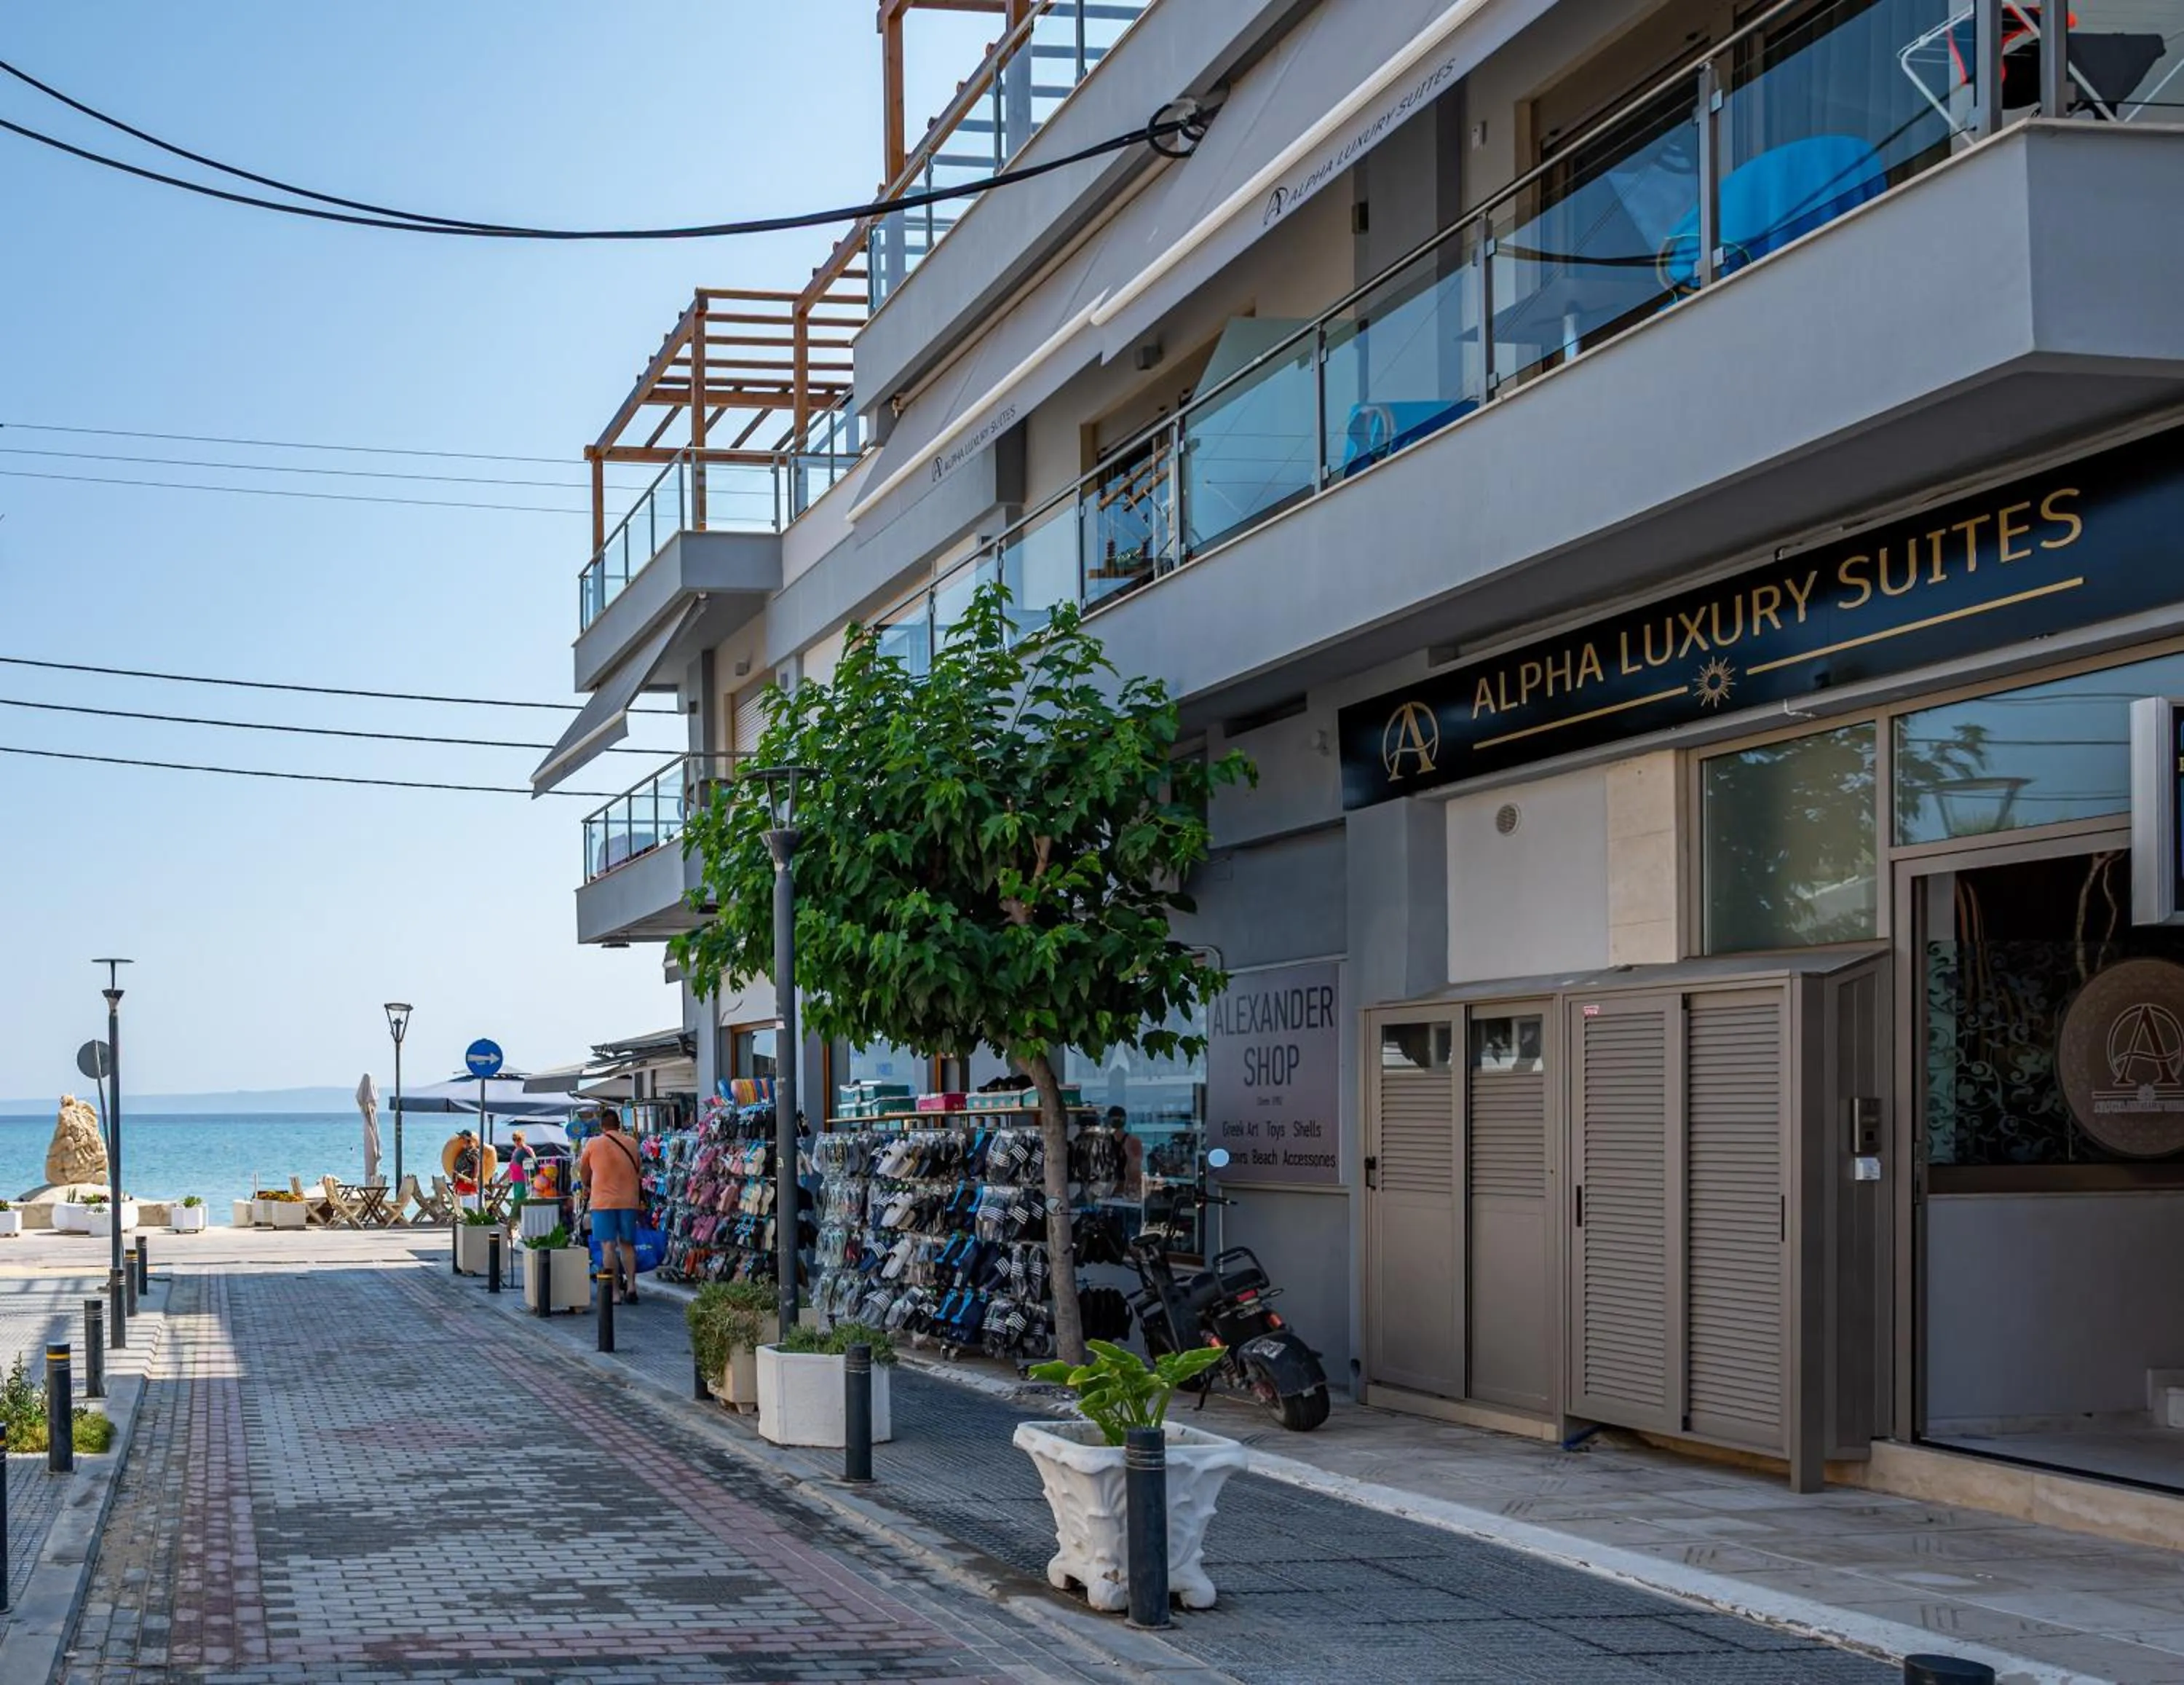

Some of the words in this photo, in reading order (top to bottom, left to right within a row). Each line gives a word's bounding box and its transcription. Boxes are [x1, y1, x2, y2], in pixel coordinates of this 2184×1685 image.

[1289, 160, 1333, 206] ALPHA
[1337, 108, 1395, 166] LUXURY
[1396, 58, 1455, 117] SUITES
[1472, 642, 1604, 719] ALPHA
[1620, 570, 1819, 675] LUXURY
[1838, 488, 2084, 609] SUITES
[1213, 985, 1334, 1036] ALEXANDER
[1243, 1044, 1299, 1087] SHOP
[1222, 1119, 1244, 1137] Greek
[1246, 1121, 1259, 1137] Art
[1266, 1120, 1286, 1141] Toys
[1293, 1119, 1322, 1137] Shells
[1251, 1148, 1278, 1166] Beach
[1282, 1148, 1336, 1168] Accessories
